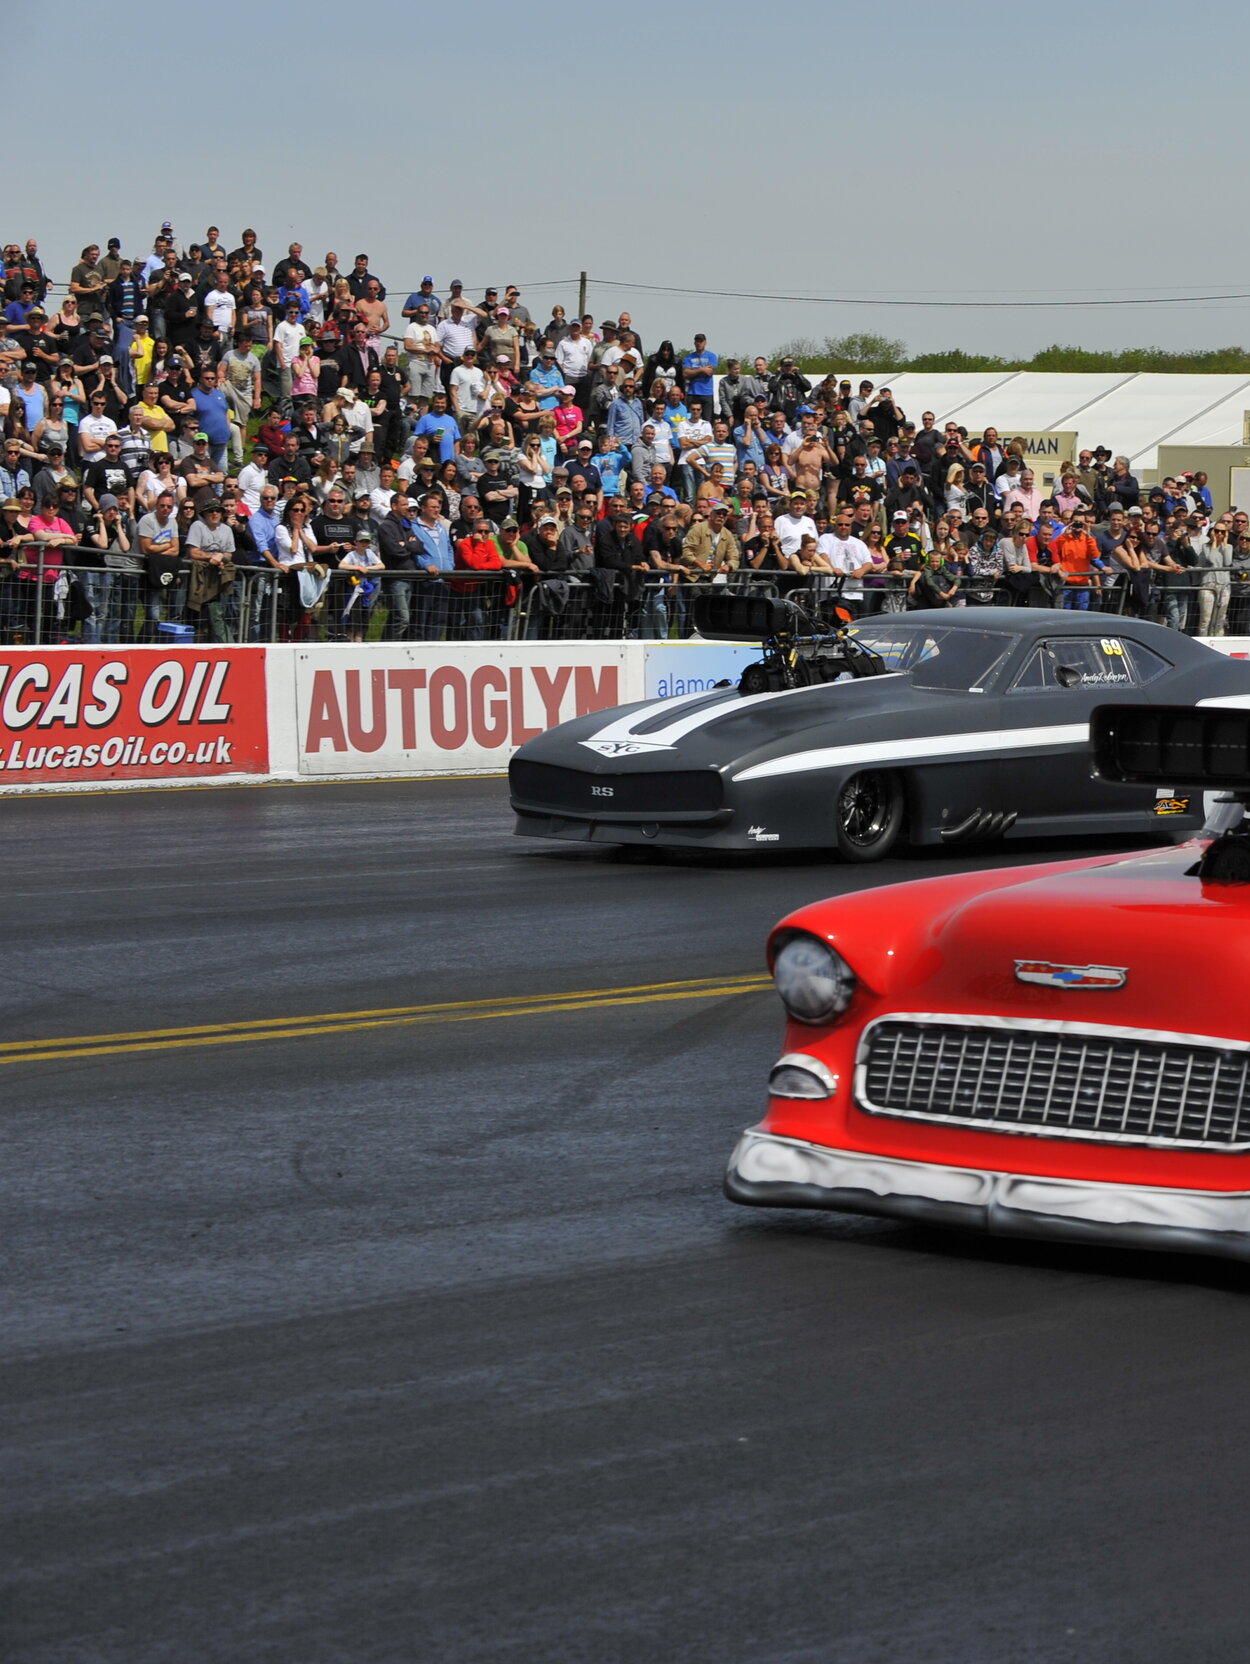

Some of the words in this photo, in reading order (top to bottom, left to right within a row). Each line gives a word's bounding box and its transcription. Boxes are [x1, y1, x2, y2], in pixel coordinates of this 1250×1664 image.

[1100, 638, 1123, 655] 69
[0, 661, 128, 730] CAS
[138, 660, 231, 724] OIL
[305, 665, 619, 753] AUTOGLYM
[591, 786, 614, 797] RS
